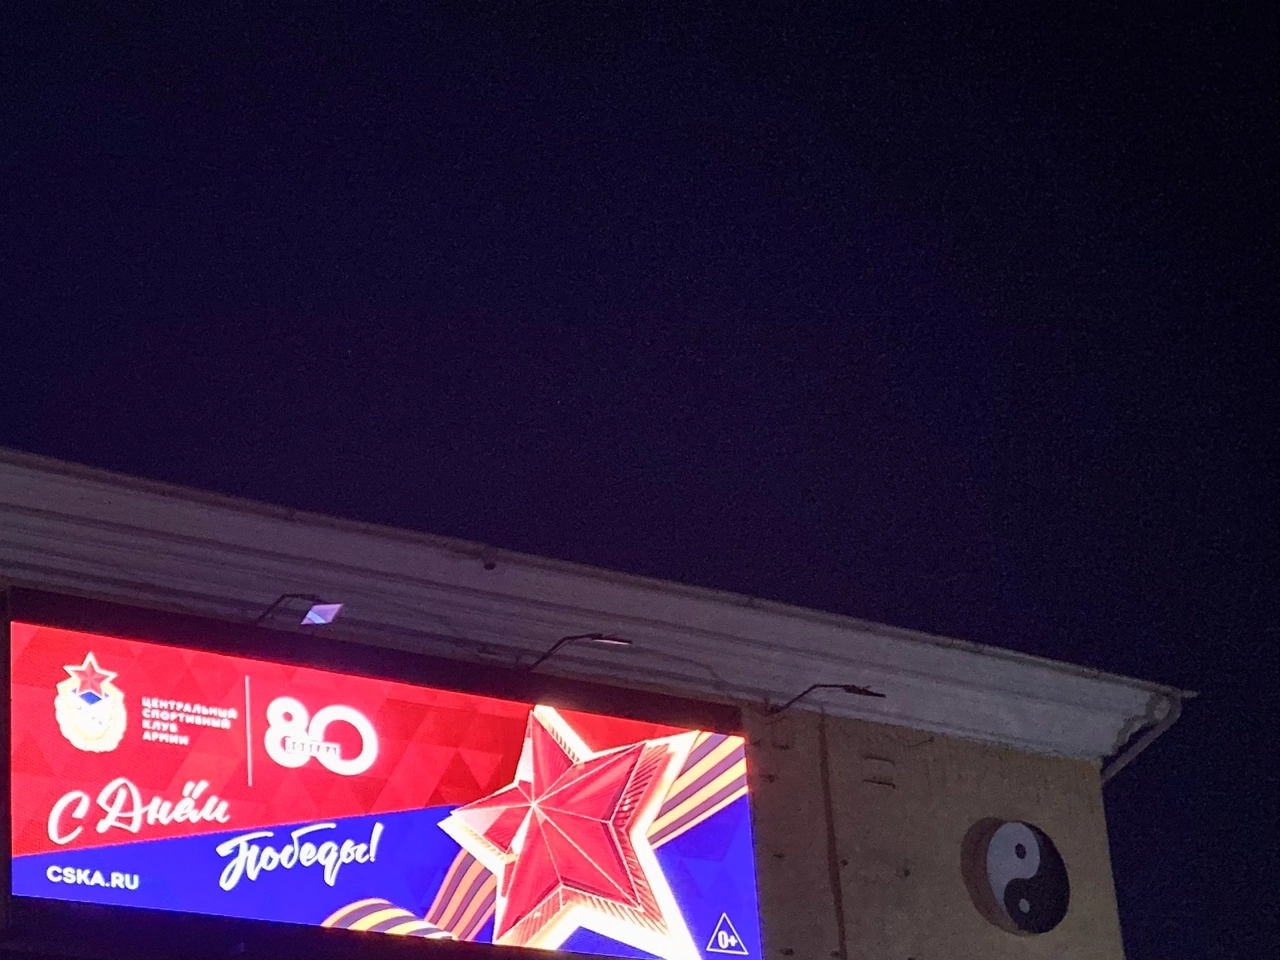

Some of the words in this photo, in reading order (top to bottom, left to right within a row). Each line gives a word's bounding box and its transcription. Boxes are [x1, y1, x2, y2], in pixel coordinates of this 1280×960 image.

[141, 696, 238, 720] ЦЕНТРАЛЬНЫЙ
[141, 708, 232, 730] СПОРТИВНЫЙ
[142, 720, 178, 733] КЛУБ
[264, 696, 379, 776] 80
[142, 732, 189, 746] АРМИИ
[47, 790, 91, 845] С
[96, 777, 231, 833] Днём
[215, 822, 385, 891] Победы!
[46, 865, 140, 890] CSKA.RU
[717, 930, 738, 949] 0+
